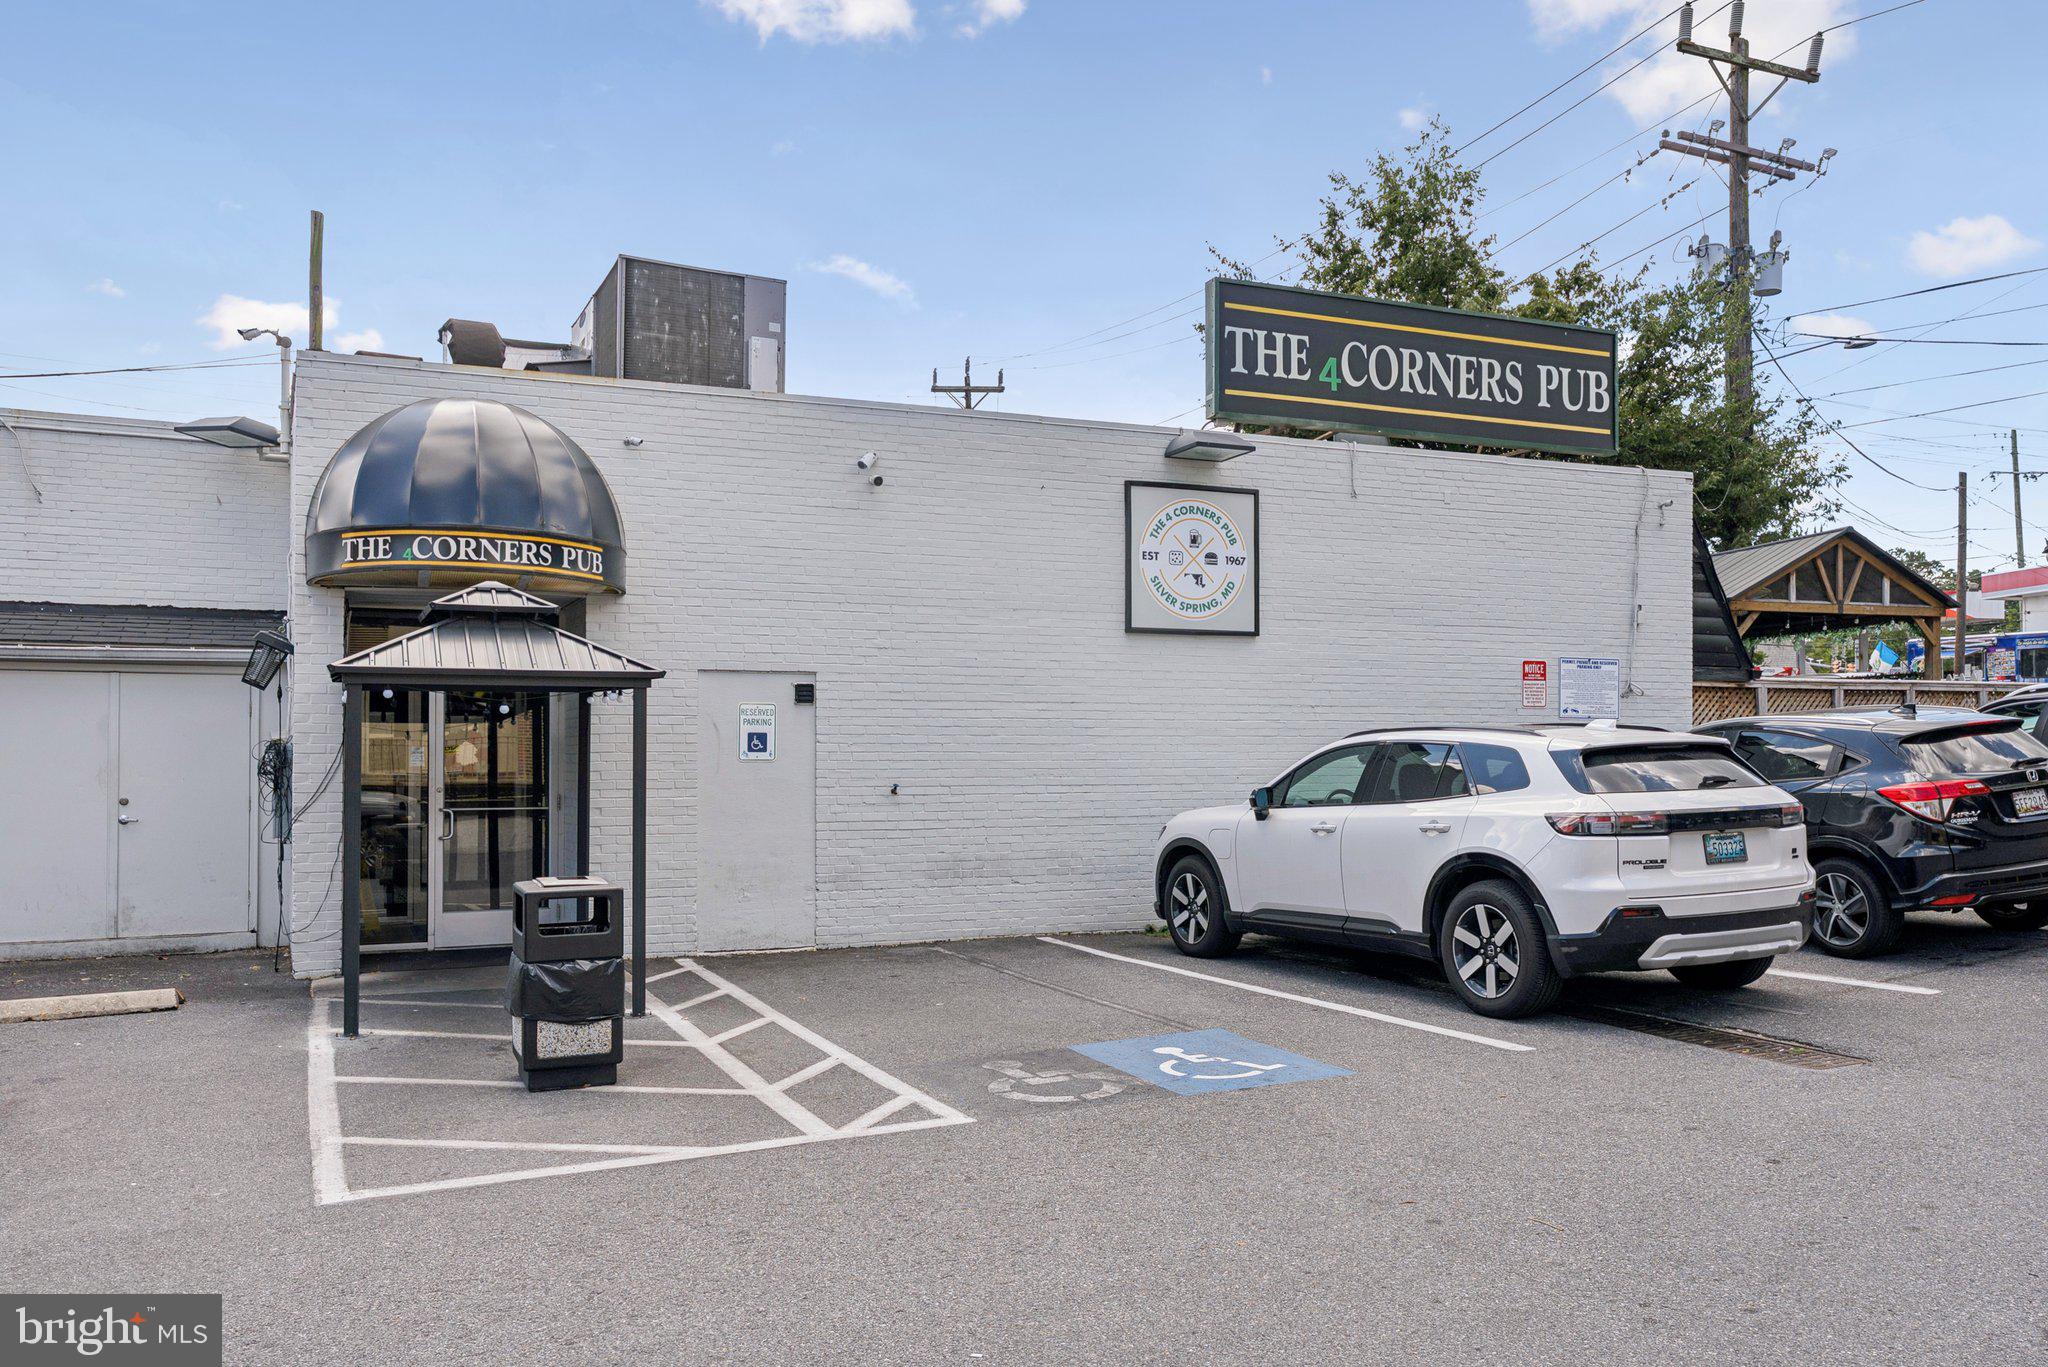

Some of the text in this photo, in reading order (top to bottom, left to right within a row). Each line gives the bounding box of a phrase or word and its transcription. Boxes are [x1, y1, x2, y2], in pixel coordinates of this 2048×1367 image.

[1225, 325, 1311, 381] THE
[1537, 364, 1610, 414] PUB
[1149, 505, 1238, 546] THE 4 CORNERS PUB
[341, 536, 392, 562] THE
[561, 546, 603, 574] PUB
[1142, 551, 1160, 561] EST
[1225, 555, 1246, 566] 1967
[1150, 575, 1236, 613] SILVER SPRING, MD
[1525, 664, 1544, 673] NOTICE
[741, 708, 774, 717] RESERVED
[743, 718, 772, 726] PARKING
[1951, 810, 1980, 818] HR-V
